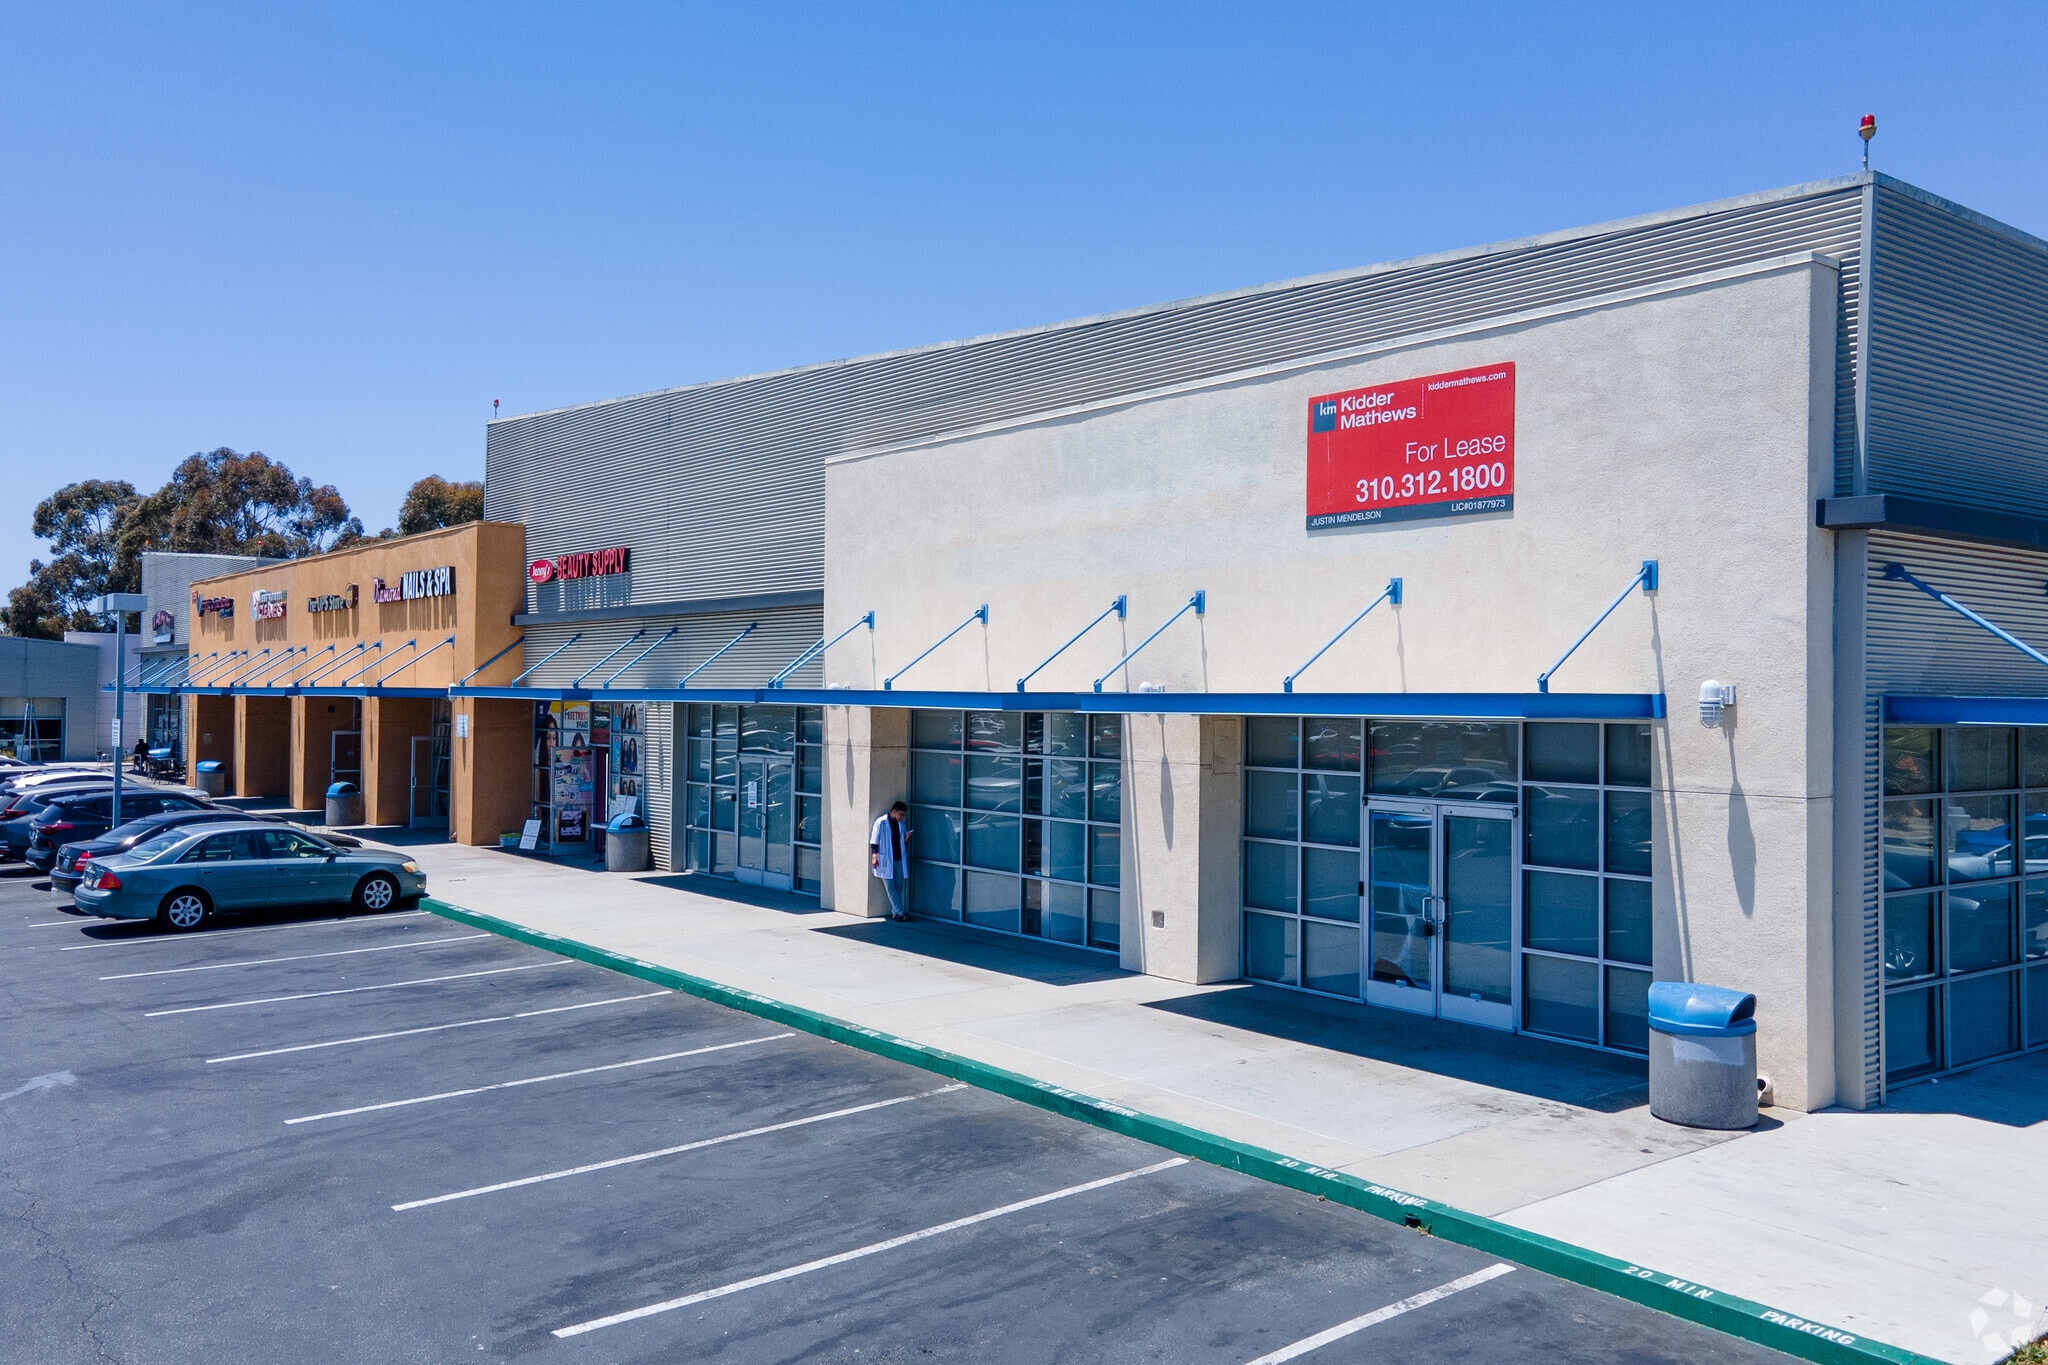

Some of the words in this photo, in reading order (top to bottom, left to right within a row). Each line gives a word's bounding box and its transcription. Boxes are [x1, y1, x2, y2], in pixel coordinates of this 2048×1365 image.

[1428, 372, 1506, 392] kiddermathews.com
[1320, 402, 1337, 416] km
[1340, 392, 1394, 412] Kidder
[1340, 406, 1416, 430] Mathews
[1405, 442, 1438, 464] For
[1444, 434, 1506, 460] Lease
[1356, 462, 1506, 503] 310.312.1800
[1311, 514, 1336, 526] JUSTIN
[1336, 510, 1382, 524] MENDELSON
[1451, 499, 1506, 512] LIC#01877973
[557, 554, 590, 580] BEAUTY
[592, 547, 626, 576] SUPPLY
[402, 570, 426, 600] NAILS
[426, 569, 434, 598] &
[434, 566, 450, 596] SPA
[1275, 1158, 1300, 1168] 20
[1364, 1185, 1428, 1208] PARKING
[1621, 1266, 1653, 1279] 20
[1665, 1279, 1714, 1300] MIN
[1760, 1310, 1856, 1346] PARKING
